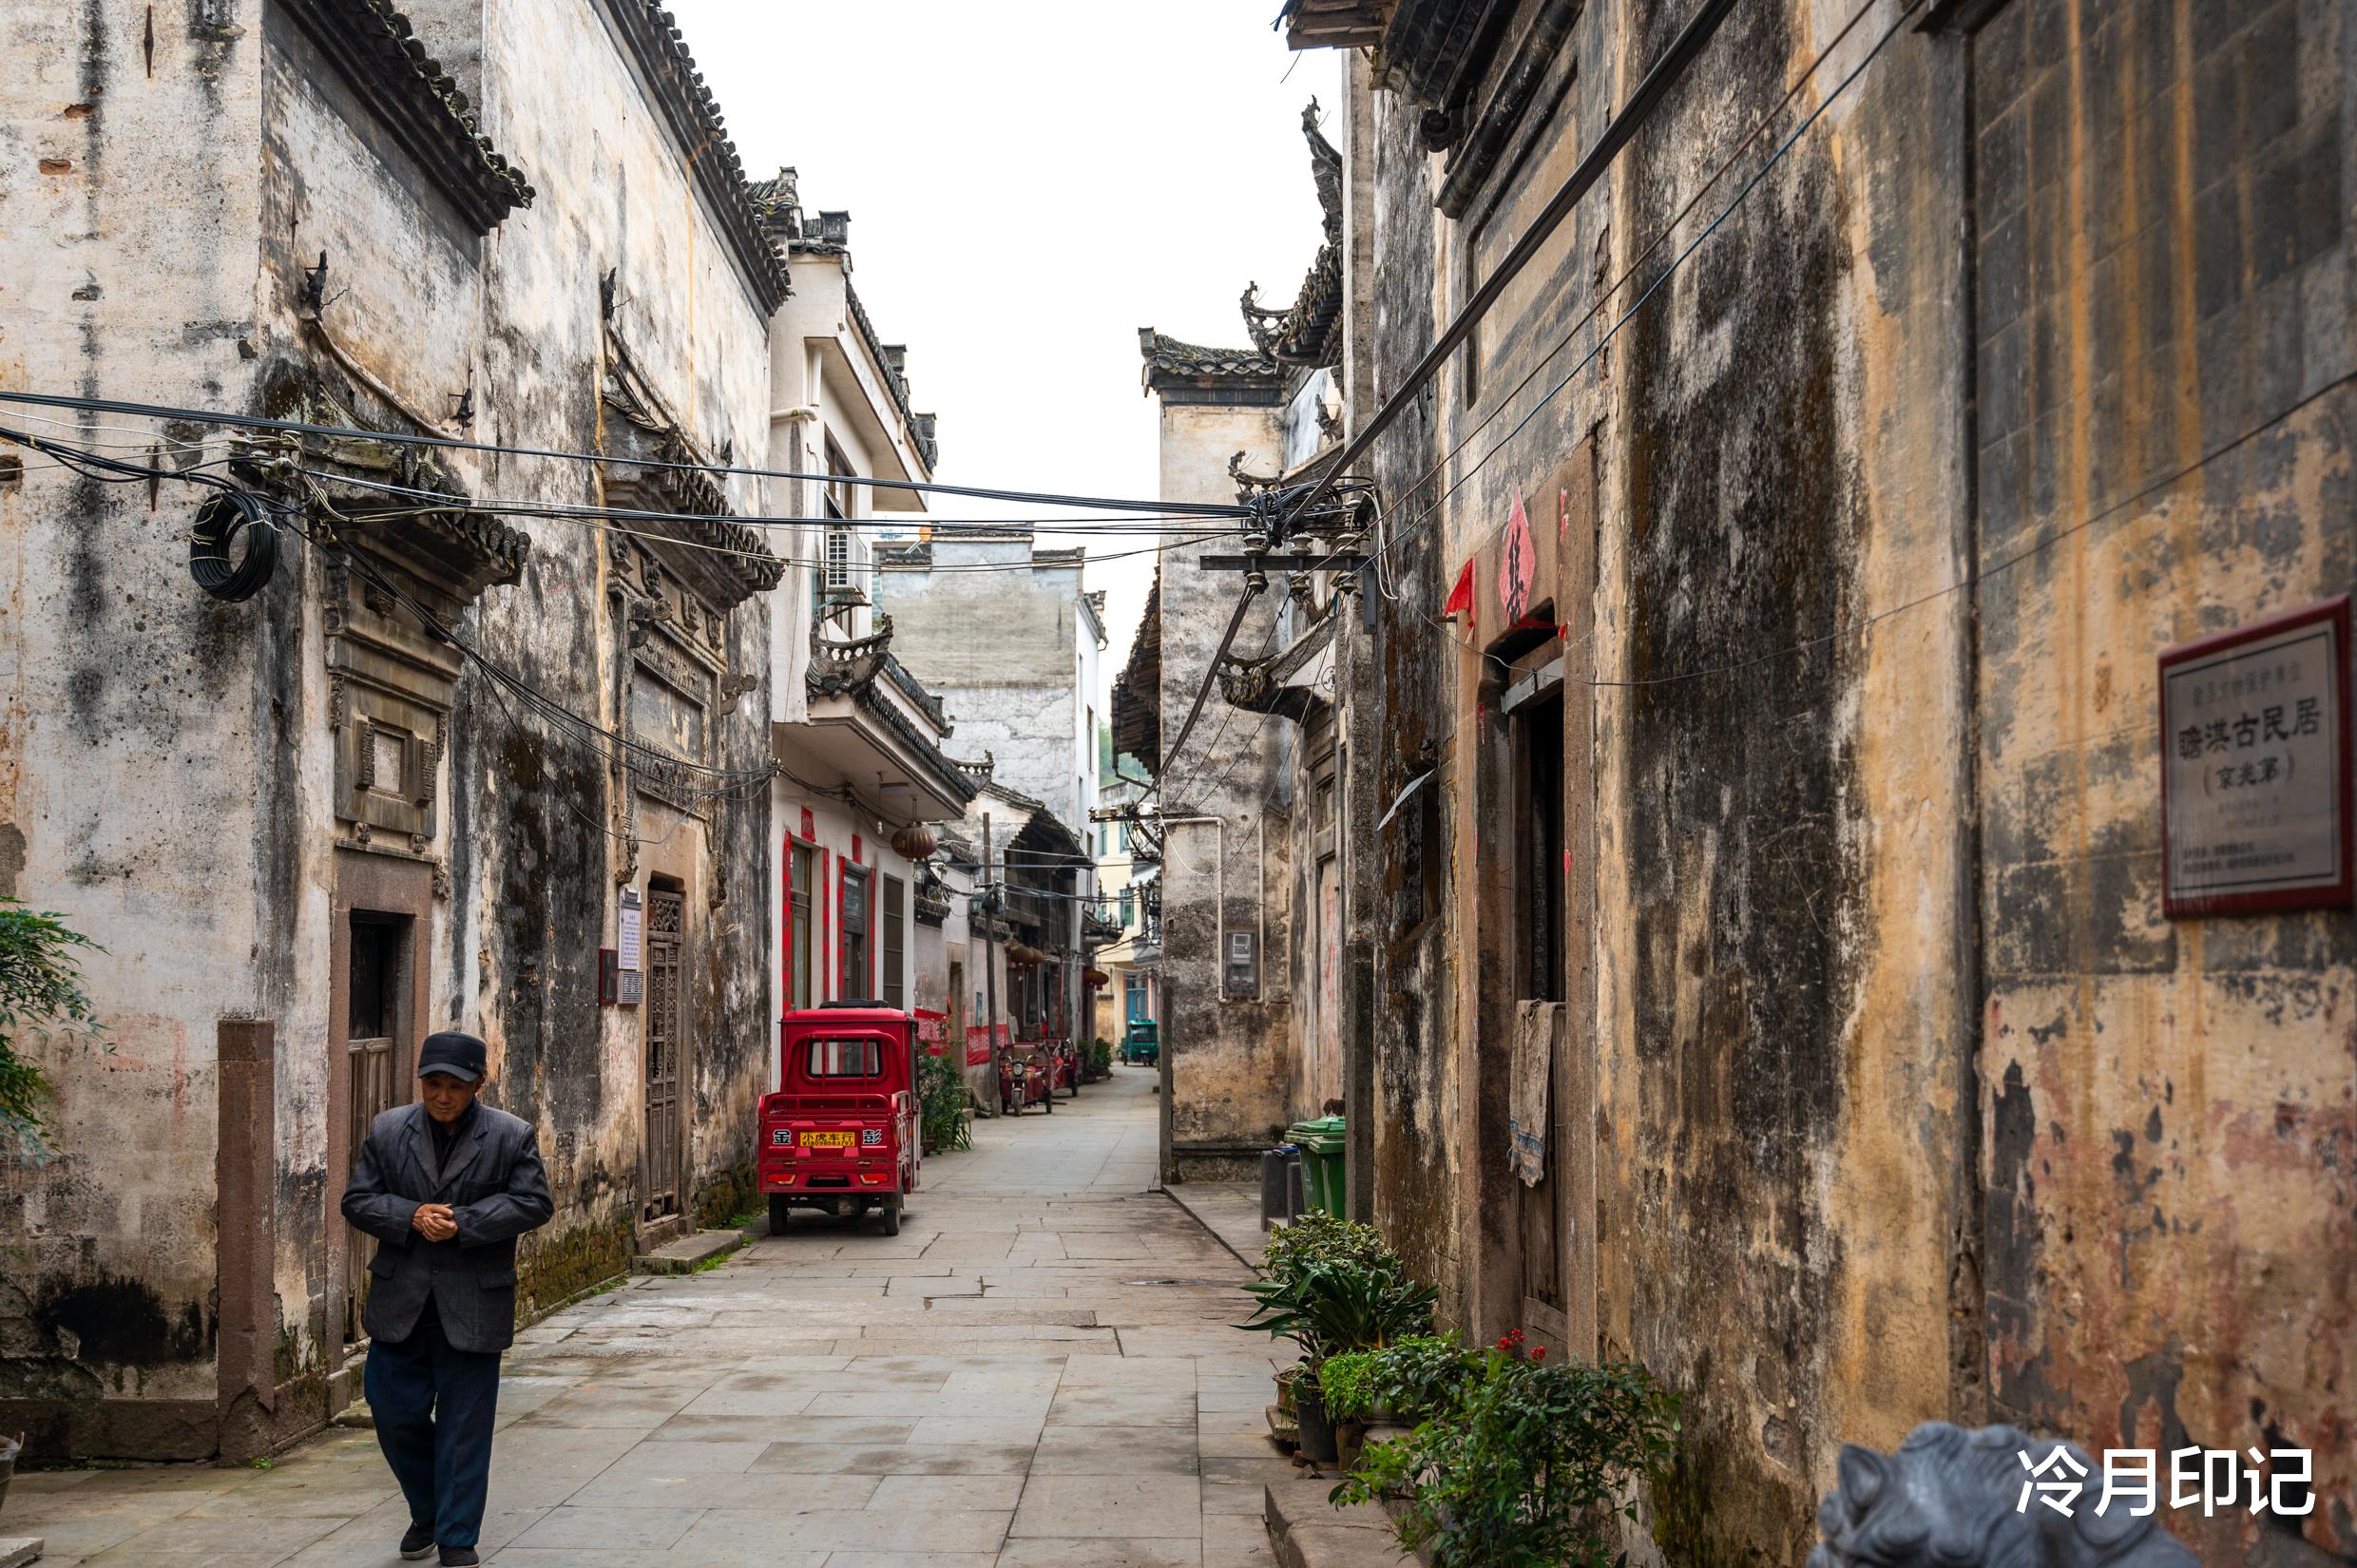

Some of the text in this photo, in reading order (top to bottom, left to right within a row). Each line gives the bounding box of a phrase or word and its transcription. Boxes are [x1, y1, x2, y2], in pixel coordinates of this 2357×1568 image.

[773, 1129, 881, 1144] 金 彭
[802, 1133, 853, 1141] 小虎车行
